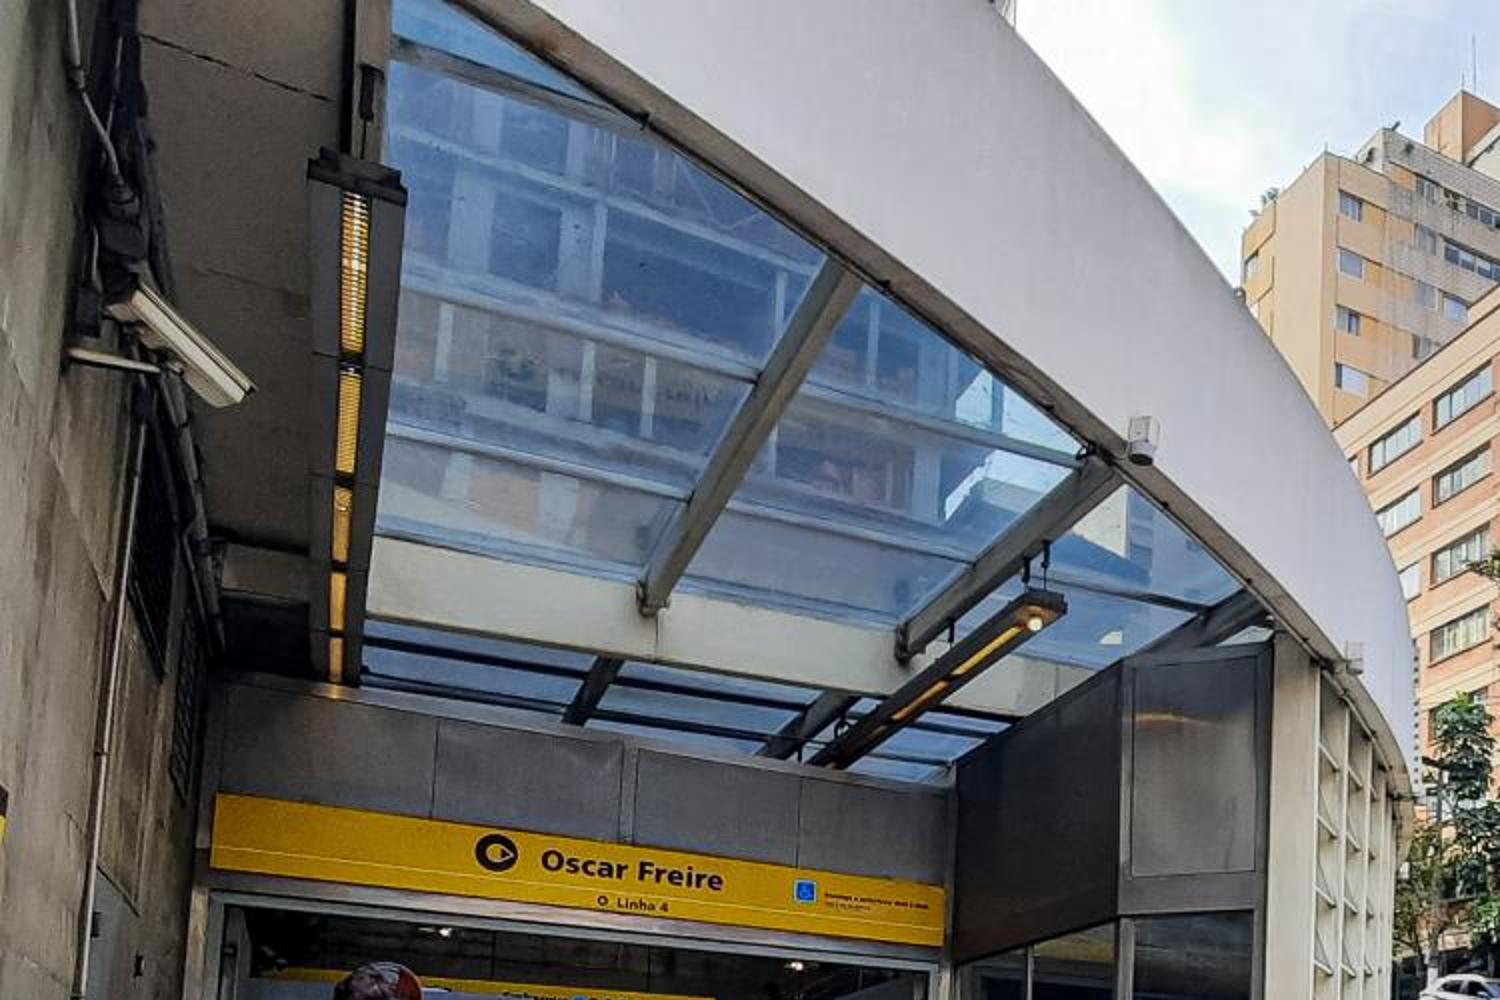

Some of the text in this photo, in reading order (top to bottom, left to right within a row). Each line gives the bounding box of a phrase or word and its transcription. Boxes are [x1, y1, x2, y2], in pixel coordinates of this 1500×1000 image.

[541, 849, 724, 891] Oscar Freire
[617, 897, 669, 913] Linha 4
